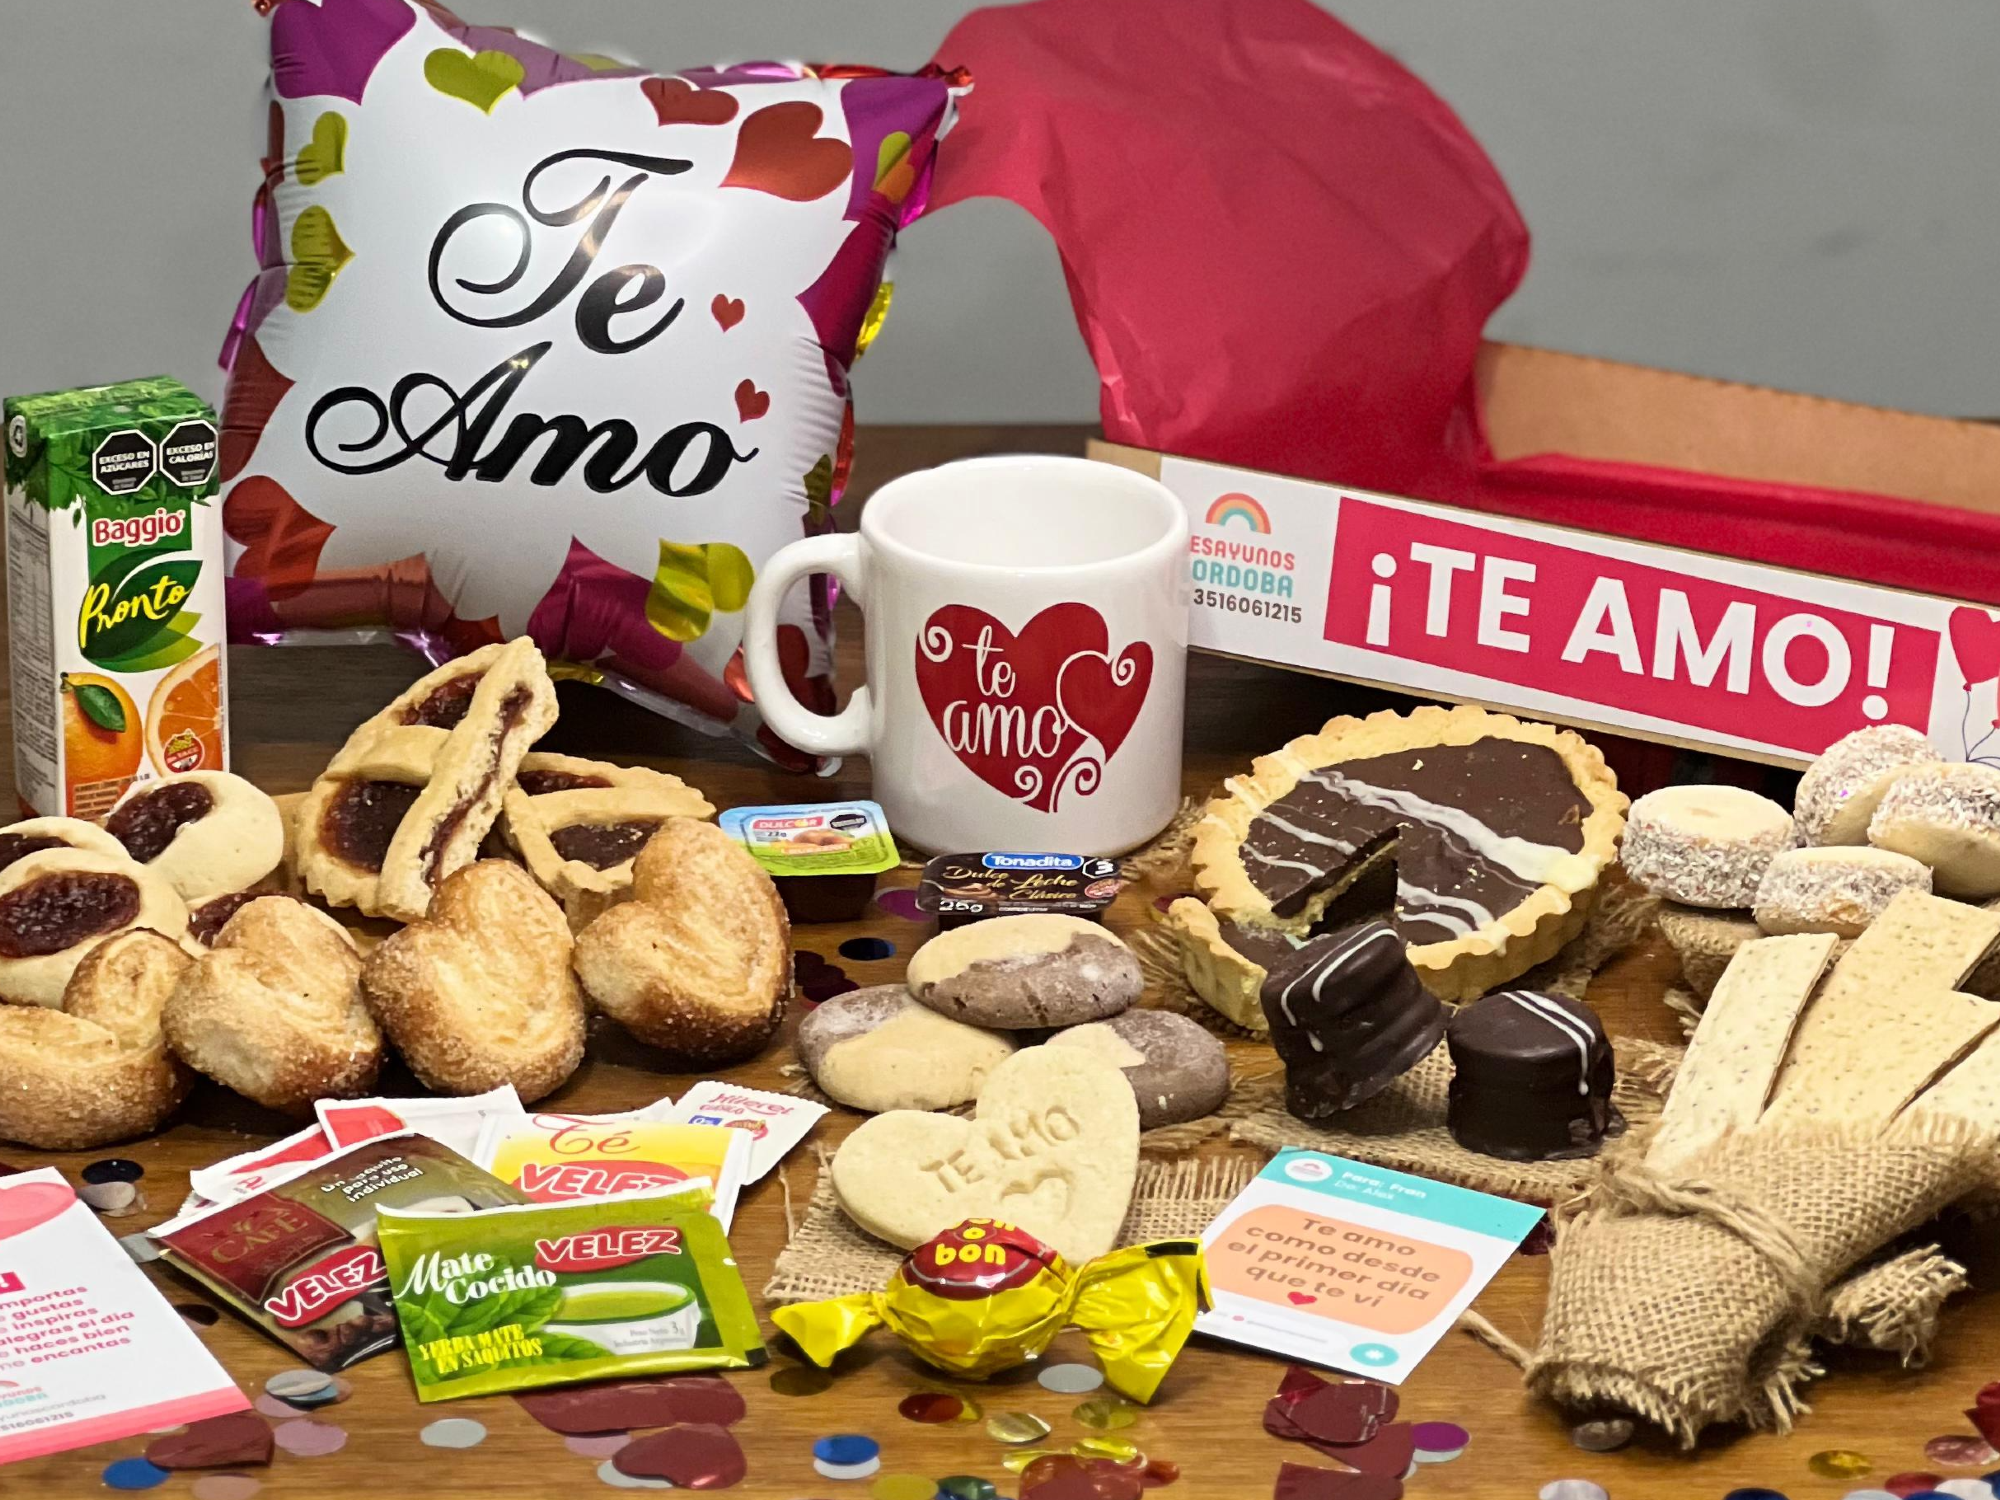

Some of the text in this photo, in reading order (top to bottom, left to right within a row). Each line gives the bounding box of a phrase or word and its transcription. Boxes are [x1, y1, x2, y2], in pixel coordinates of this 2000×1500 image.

[428, 148, 694, 355] Te
[305, 341, 760, 498] Amo
[99, 450, 150, 465] EXCESO EN
[166, 443, 203, 456] EXCESO
[93, 508, 183, 547] Baggio
[1189, 535, 1296, 571] ESAYUNOS
[1191, 559, 1294, 599] ORDOBA
[80, 575, 192, 650] Pronto
[1193, 588, 1302, 624] 3516061215
[1365, 541, 1895, 721] ¡TE AMO!
[961, 624, 1016, 698] te
[943, 700, 1068, 759] amo
[942, 865, 1010, 880] Dulce
[990, 855, 1073, 868] Tonadita
[320, 1180, 346, 1192] Un
[341, 1174, 379, 1194] para
[346, 1167, 424, 1203] individual
[534, 1228, 682, 1263] VELEZ
[934, 1242, 1007, 1267] bon
[1246, 1226, 1441, 1282] como desde
[1303, 1218, 1417, 1257] Te amo
[393, 1250, 496, 1300] Mate
[1227, 1241, 1259, 1256] el
[1257, 1249, 1372, 1285] primer
[0, 1286, 88, 1310] mportas
[264, 1250, 389, 1323] VELEZ
[445, 1266, 558, 1305] Cocido
[1245, 1265, 1308, 1287] que
[1313, 1281, 1346, 1298] te
[11, 1299, 84, 1321] gustas
[14, 1336, 80, 1355] haces
[30, 1337, 132, 1364] encantas
[461, 1337, 543, 1368] SAQUITOS
